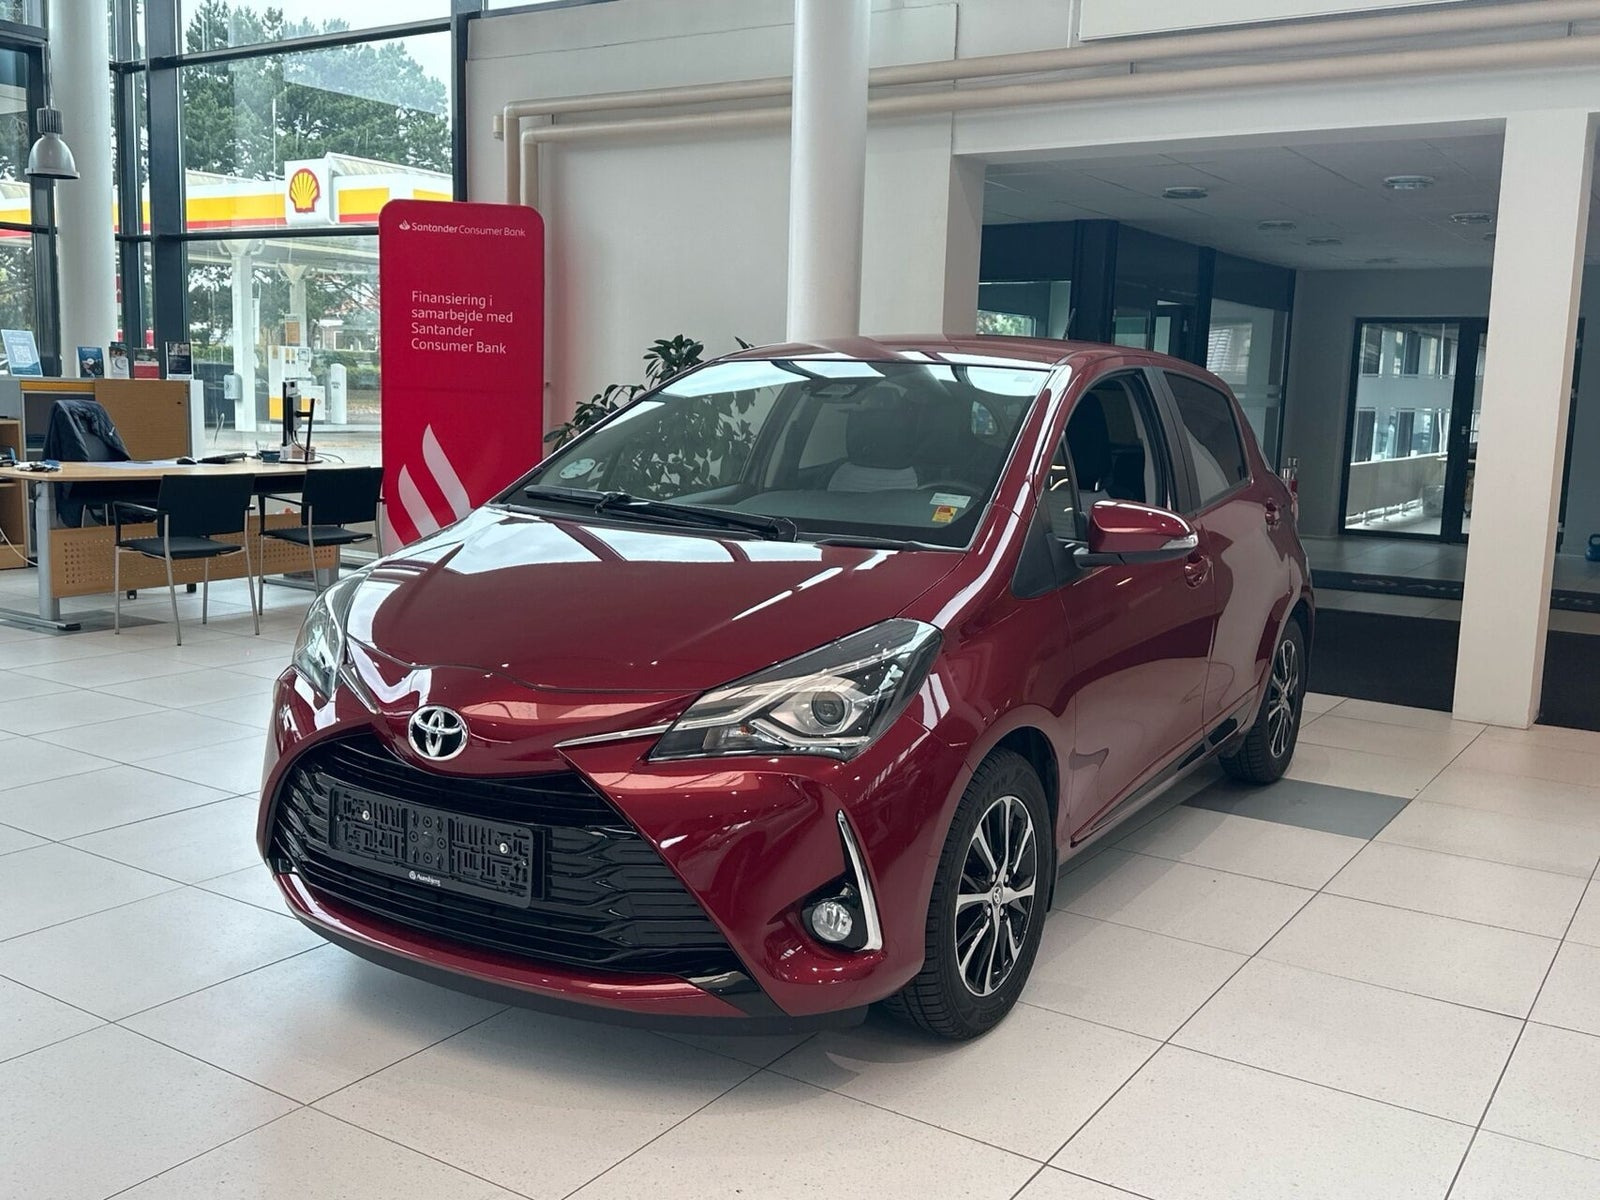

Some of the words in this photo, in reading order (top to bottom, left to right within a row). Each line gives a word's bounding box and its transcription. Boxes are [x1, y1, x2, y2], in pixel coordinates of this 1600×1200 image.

[411, 222, 458, 233] Santander
[458, 224, 502, 236] Consumer
[504, 227, 526, 237] Bank
[411, 290, 486, 309] Finansiering
[411, 308, 483, 324] samarbejde
[486, 312, 513, 323] med
[411, 323, 474, 337] Santander
[411, 338, 473, 352] Consumer
[476, 342, 507, 355] Bank
